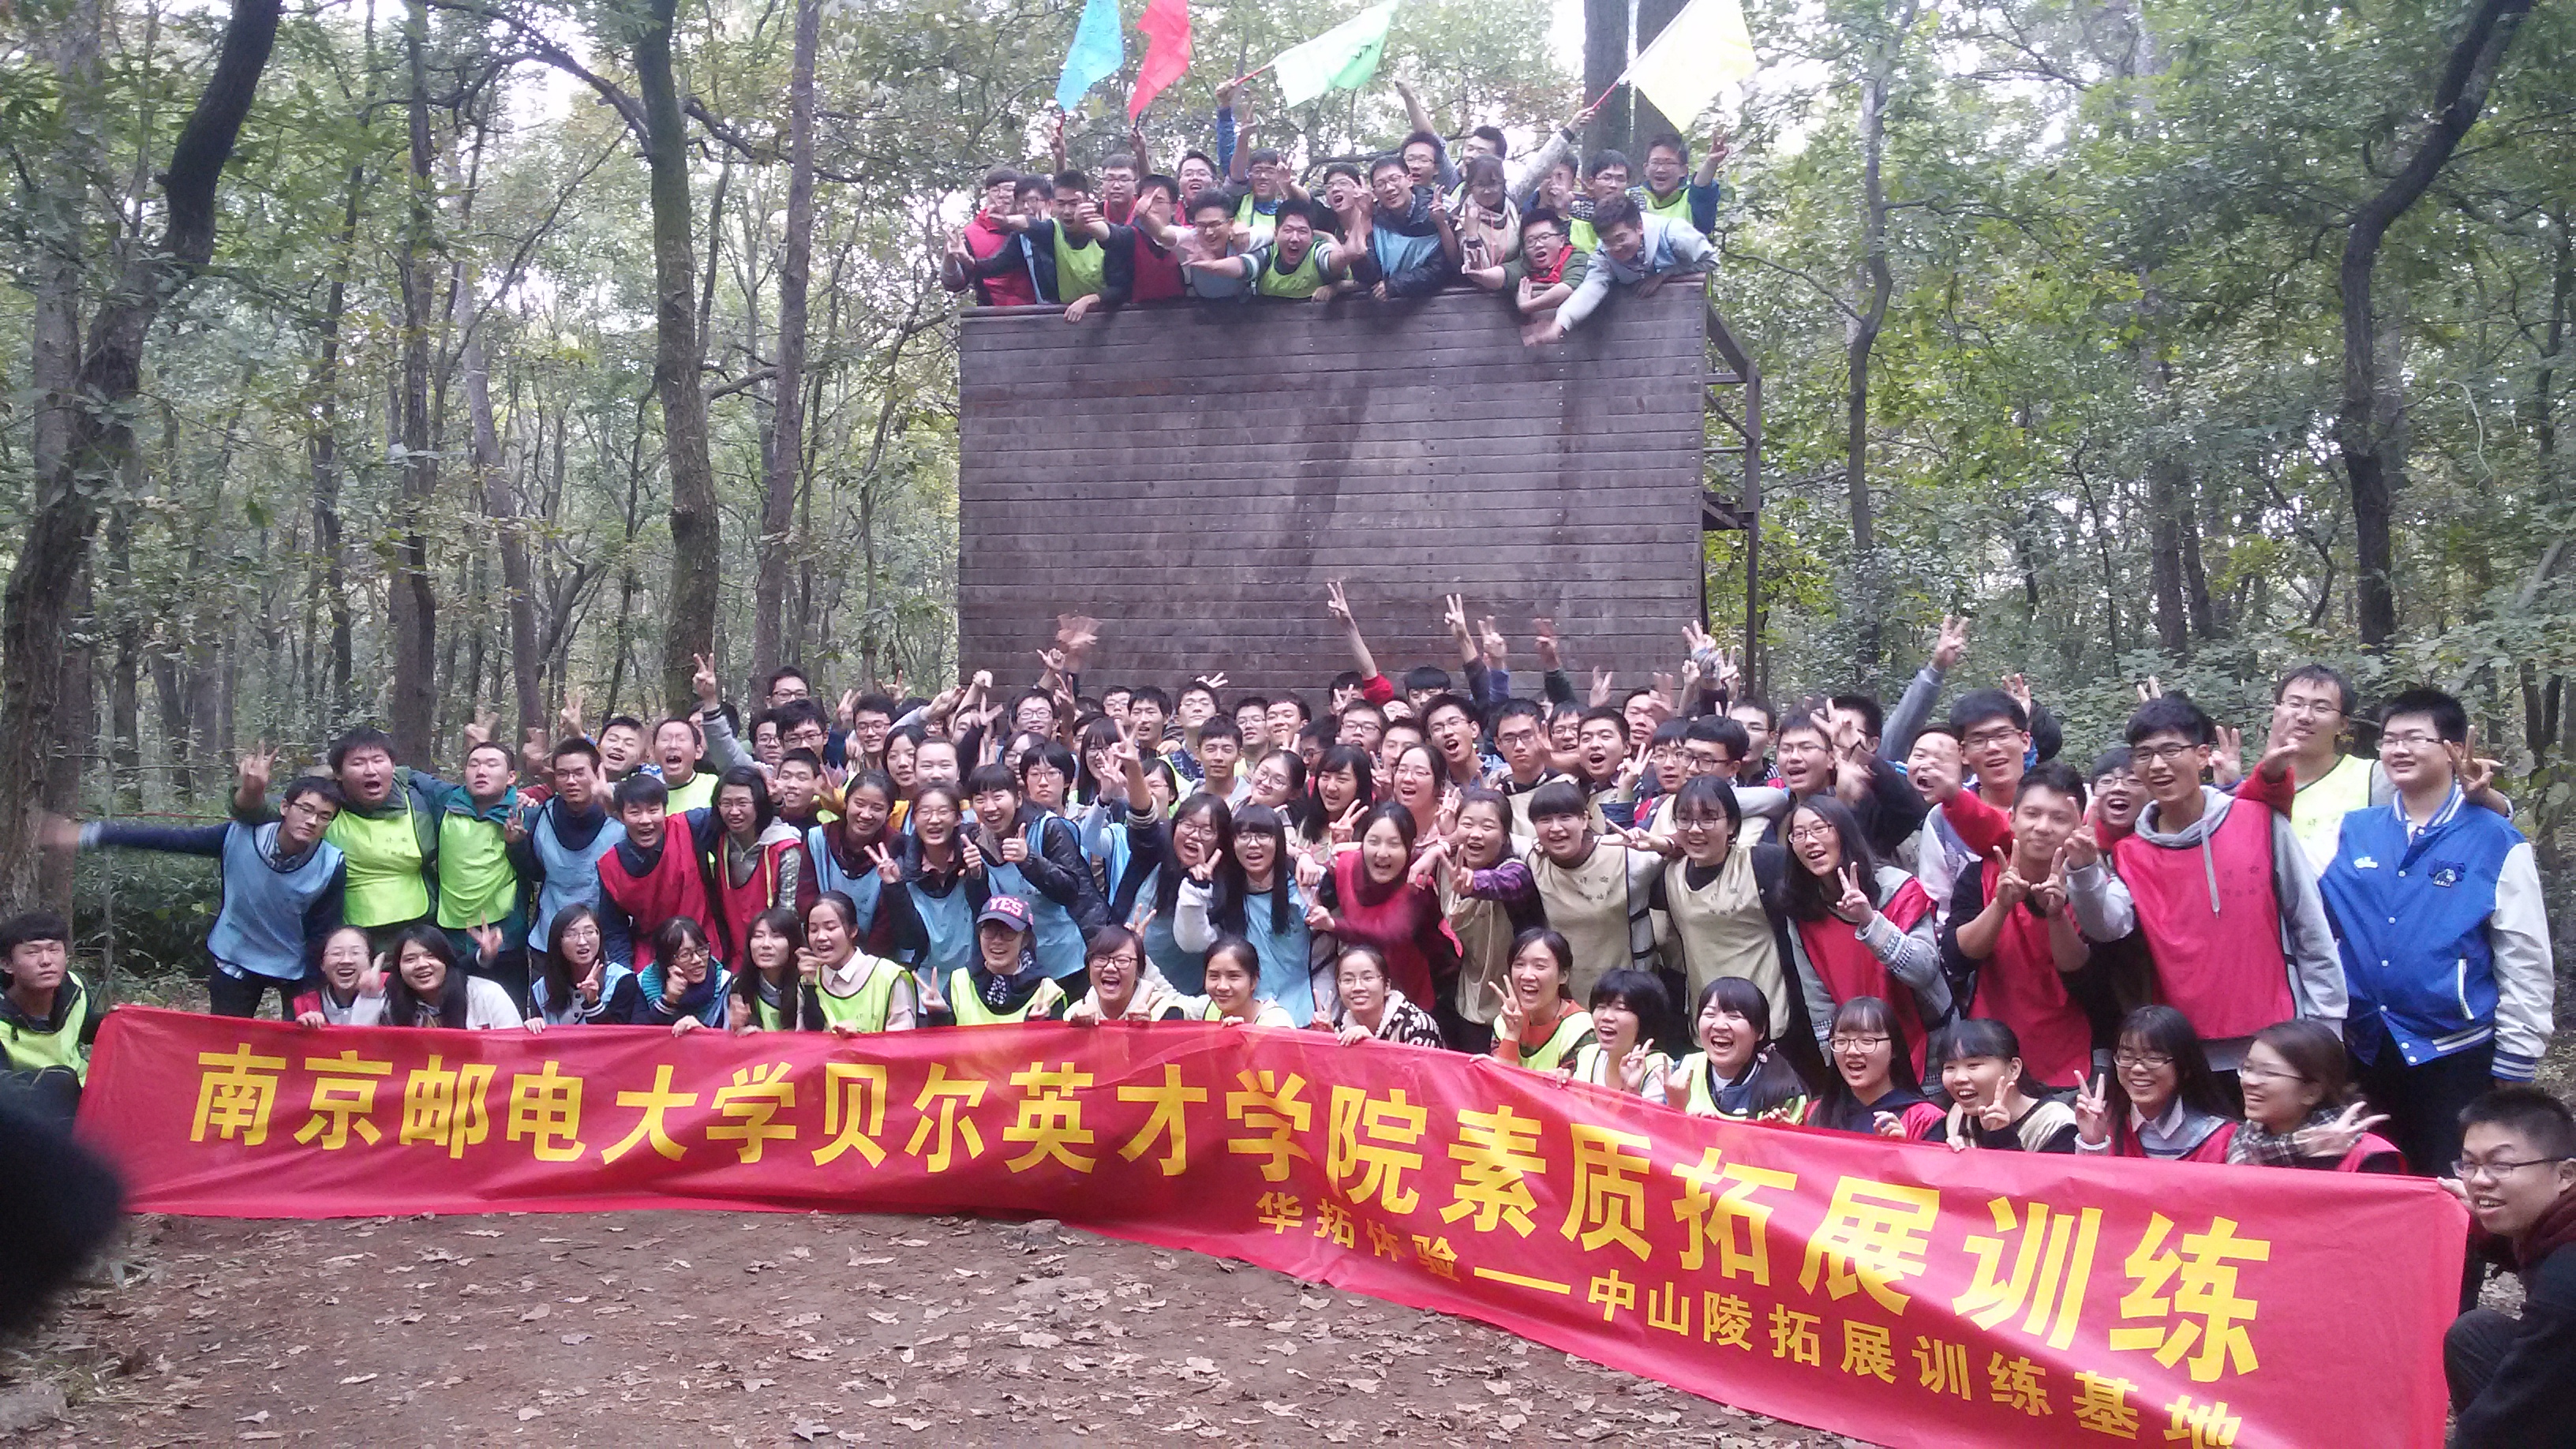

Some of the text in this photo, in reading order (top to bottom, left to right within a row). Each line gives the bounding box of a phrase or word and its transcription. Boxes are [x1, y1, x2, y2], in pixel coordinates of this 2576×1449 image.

[990, 897, 1023, 916] YES
[190, 1043, 2270, 1383] 南京邮电大学贝尔英才学院素质拓展训练
